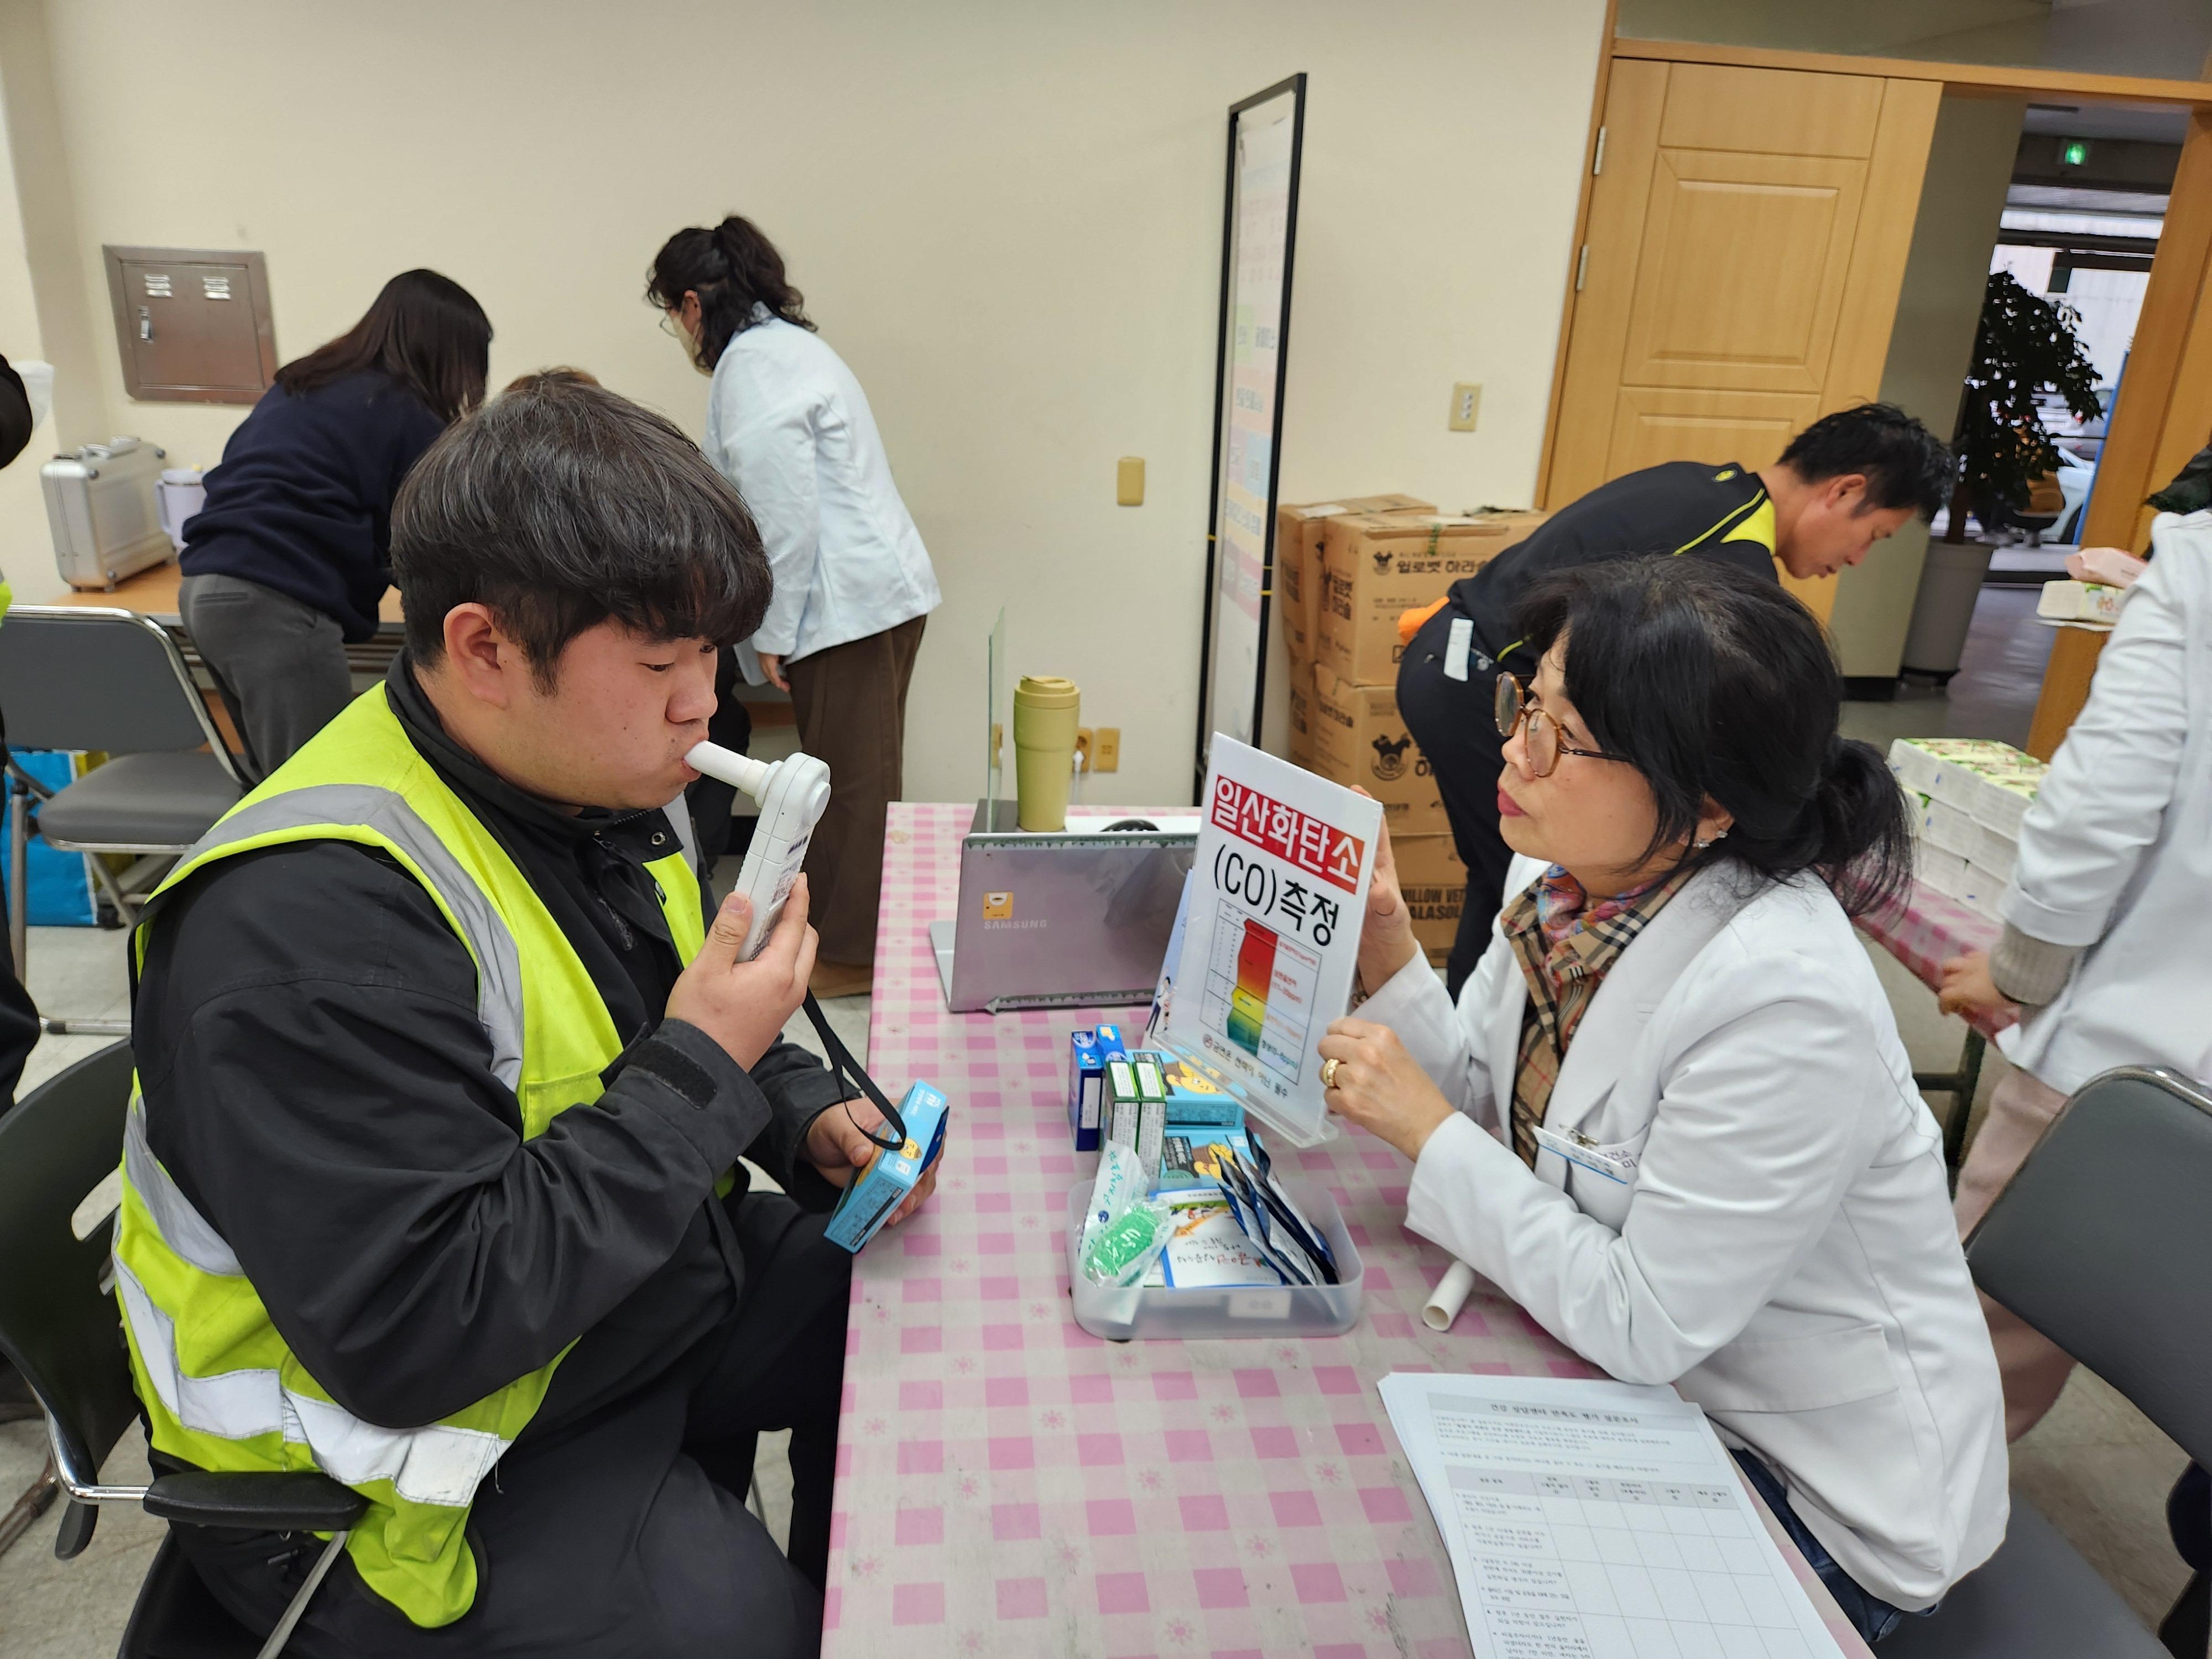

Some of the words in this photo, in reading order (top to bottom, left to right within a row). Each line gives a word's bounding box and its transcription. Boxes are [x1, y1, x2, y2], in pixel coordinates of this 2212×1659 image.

[1215, 778, 1358, 884] 일산화탄소
[984, 919, 1047, 929] SAMSUNG
[1214, 844, 1339, 946] (CO)측정
[1409, 905, 1459, 919] ALASOL
